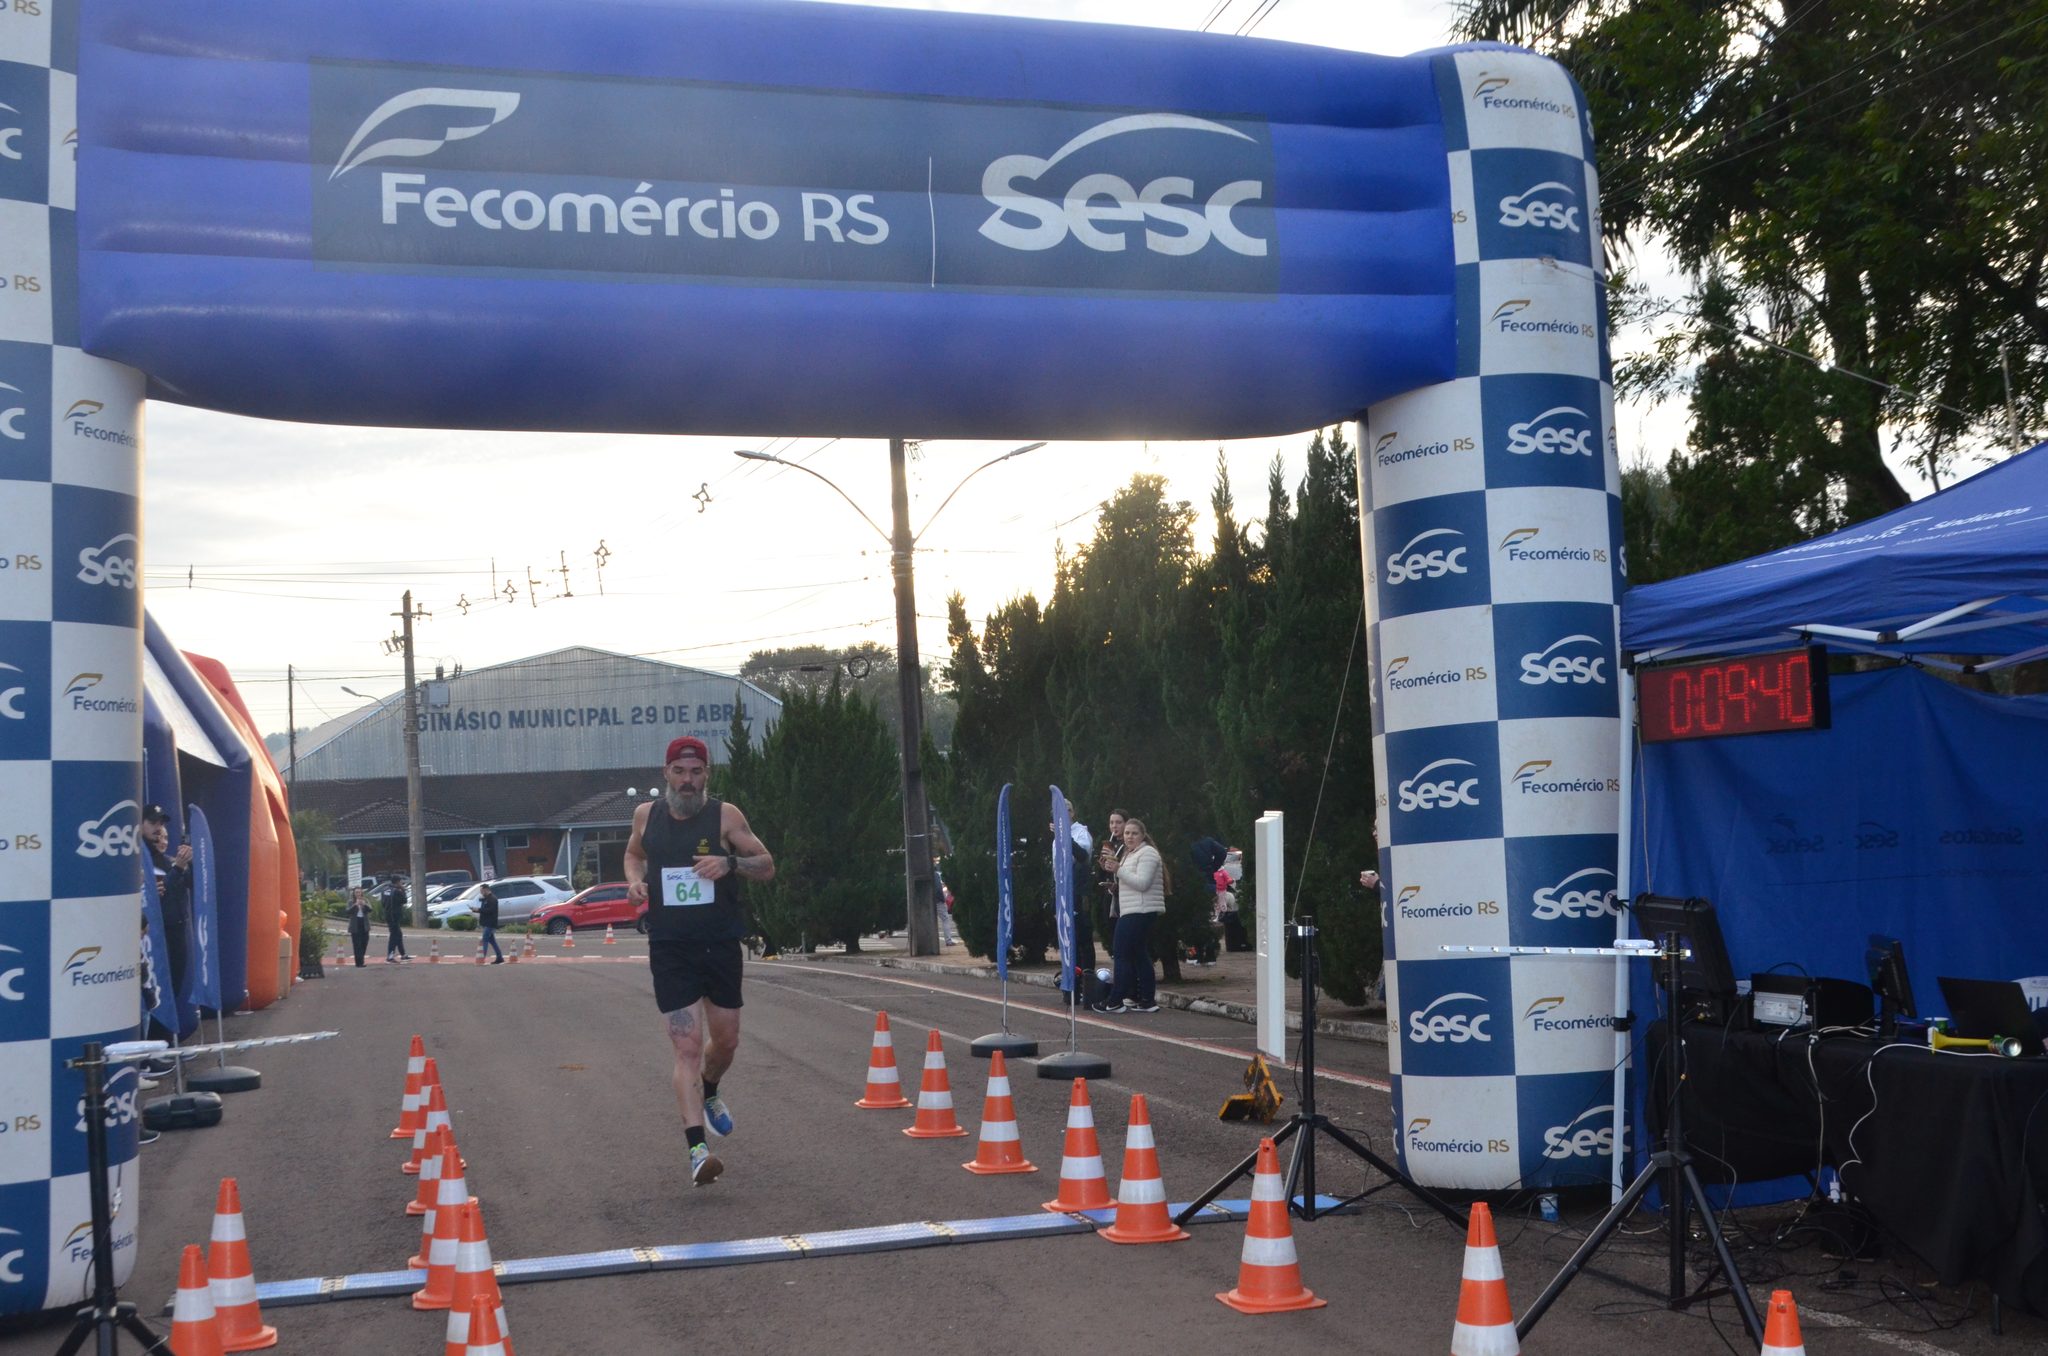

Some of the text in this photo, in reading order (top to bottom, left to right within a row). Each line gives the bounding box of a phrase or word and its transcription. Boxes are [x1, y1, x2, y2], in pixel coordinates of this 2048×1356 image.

[1483, 97, 1576, 119] Fecomércio RS
[978, 113, 1268, 257] Sesc
[381, 172, 890, 245] Fecomércio RS
[1499, 181, 1580, 233] Sesc
[14, 275, 41, 293] RS
[1501, 320, 1594, 338] Fecomércio RS
[1506, 406, 1592, 457] Sesc
[1378, 437, 1475, 467] Fecomércio RS
[16, 554, 42, 570] RS
[76, 533, 141, 590] Ses
[1386, 528, 1468, 585] Sesc
[1509, 547, 1590, 562] Fecomércio
[1593, 549, 1607, 563] RS
[1518, 634, 1606, 685] Sesc
[1390, 666, 1488, 691] Fecomércio RS
[417, 703, 754, 732] GINÁSIO MUNICIPAL 29 DE ABRL
[1398, 758, 1480, 812] Sesc
[1521, 779, 1604, 794] Fecomércio
[15, 834, 41, 850] RS
[676, 881, 702, 902] 64
[1401, 903, 1473, 919] Fecomércio
[1477, 900, 1500, 916] RS
[1409, 992, 1491, 1043] Sesc
[14, 1114, 41, 1132] RS
[1411, 1137, 1483, 1153] Fecomércio
[1488, 1138, 1510, 1153] RS
